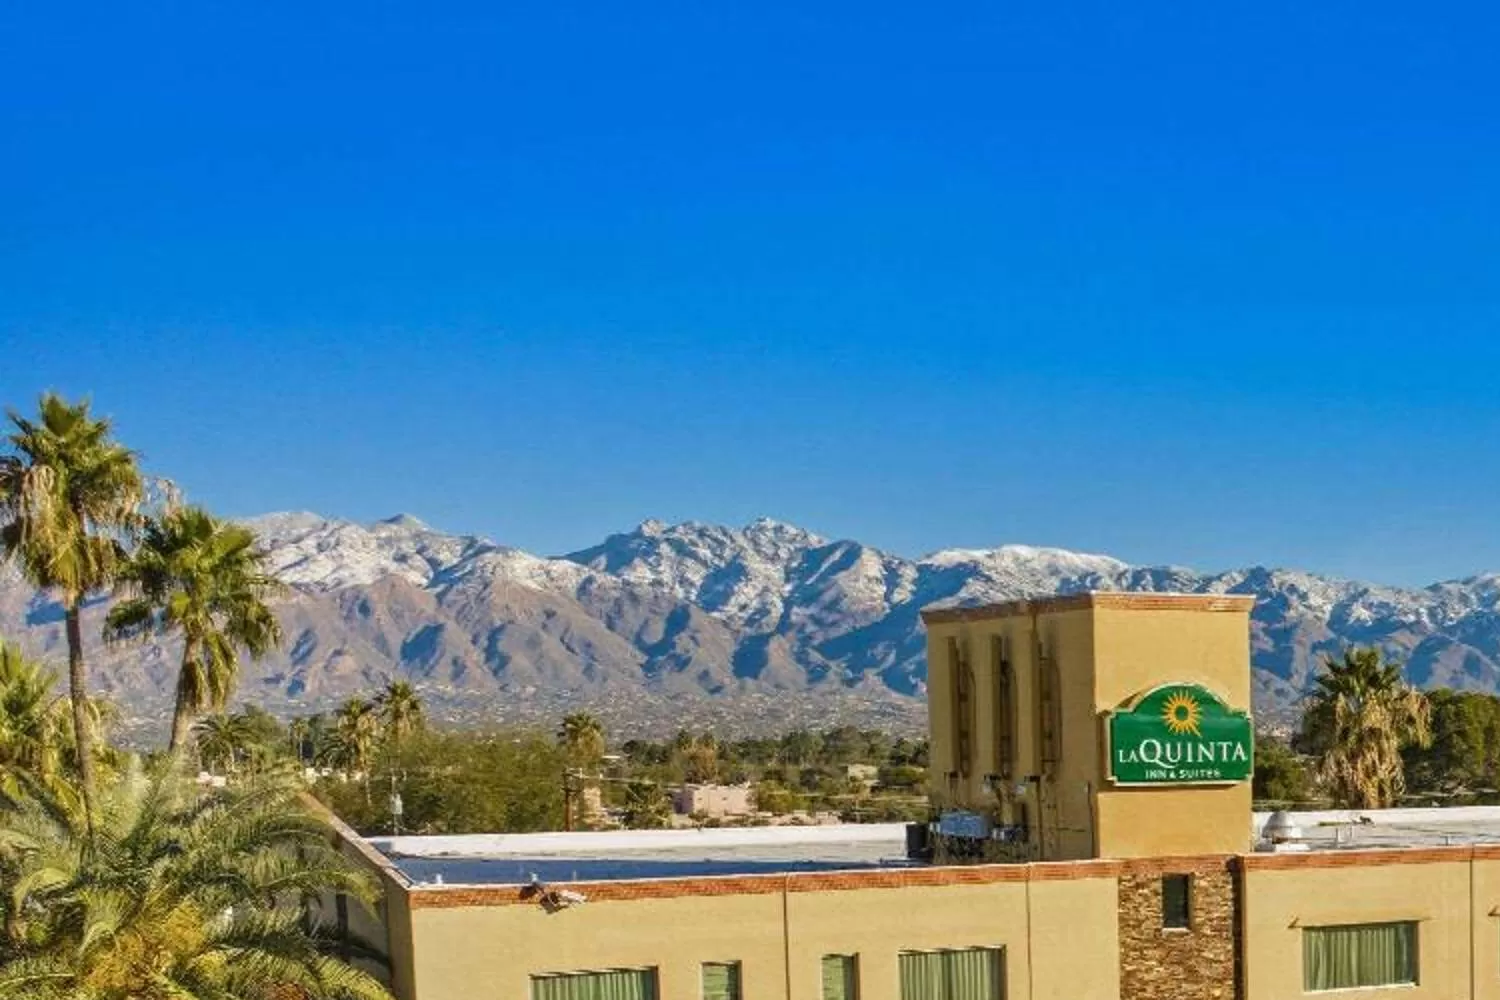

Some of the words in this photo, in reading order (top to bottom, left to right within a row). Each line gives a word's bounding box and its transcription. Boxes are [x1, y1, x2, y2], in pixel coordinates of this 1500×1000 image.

[1139, 738, 1248, 768] QUINTA
[1145, 769, 1167, 779] INN
[1179, 768, 1221, 779] SUITES
